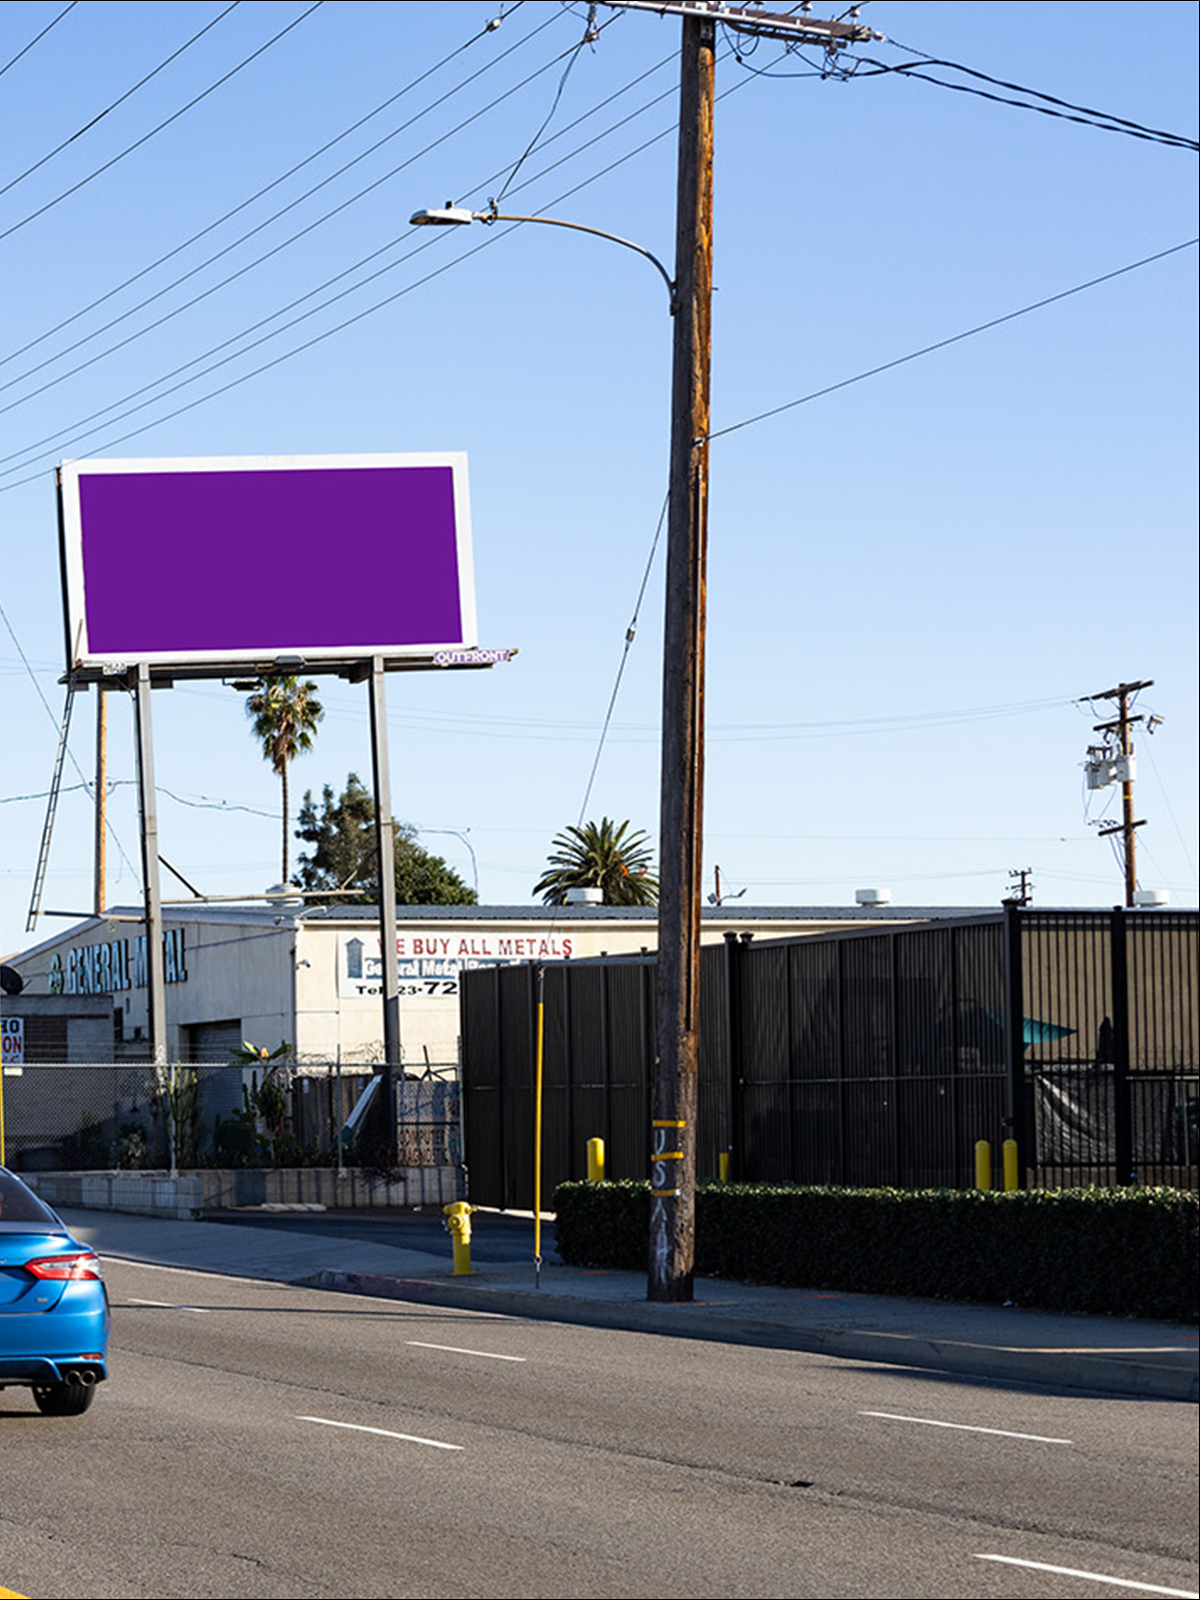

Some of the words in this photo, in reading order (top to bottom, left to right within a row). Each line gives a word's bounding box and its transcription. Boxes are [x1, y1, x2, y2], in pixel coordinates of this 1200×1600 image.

[377, 938, 405, 955] E
[413, 938, 450, 955] BUY
[458, 938, 492, 955] ALL
[500, 938, 573, 955] METALS
[67, 938, 131, 995] GENERAL
[134, 928, 188, 989] MAL
[365, 958, 419, 977] Geral
